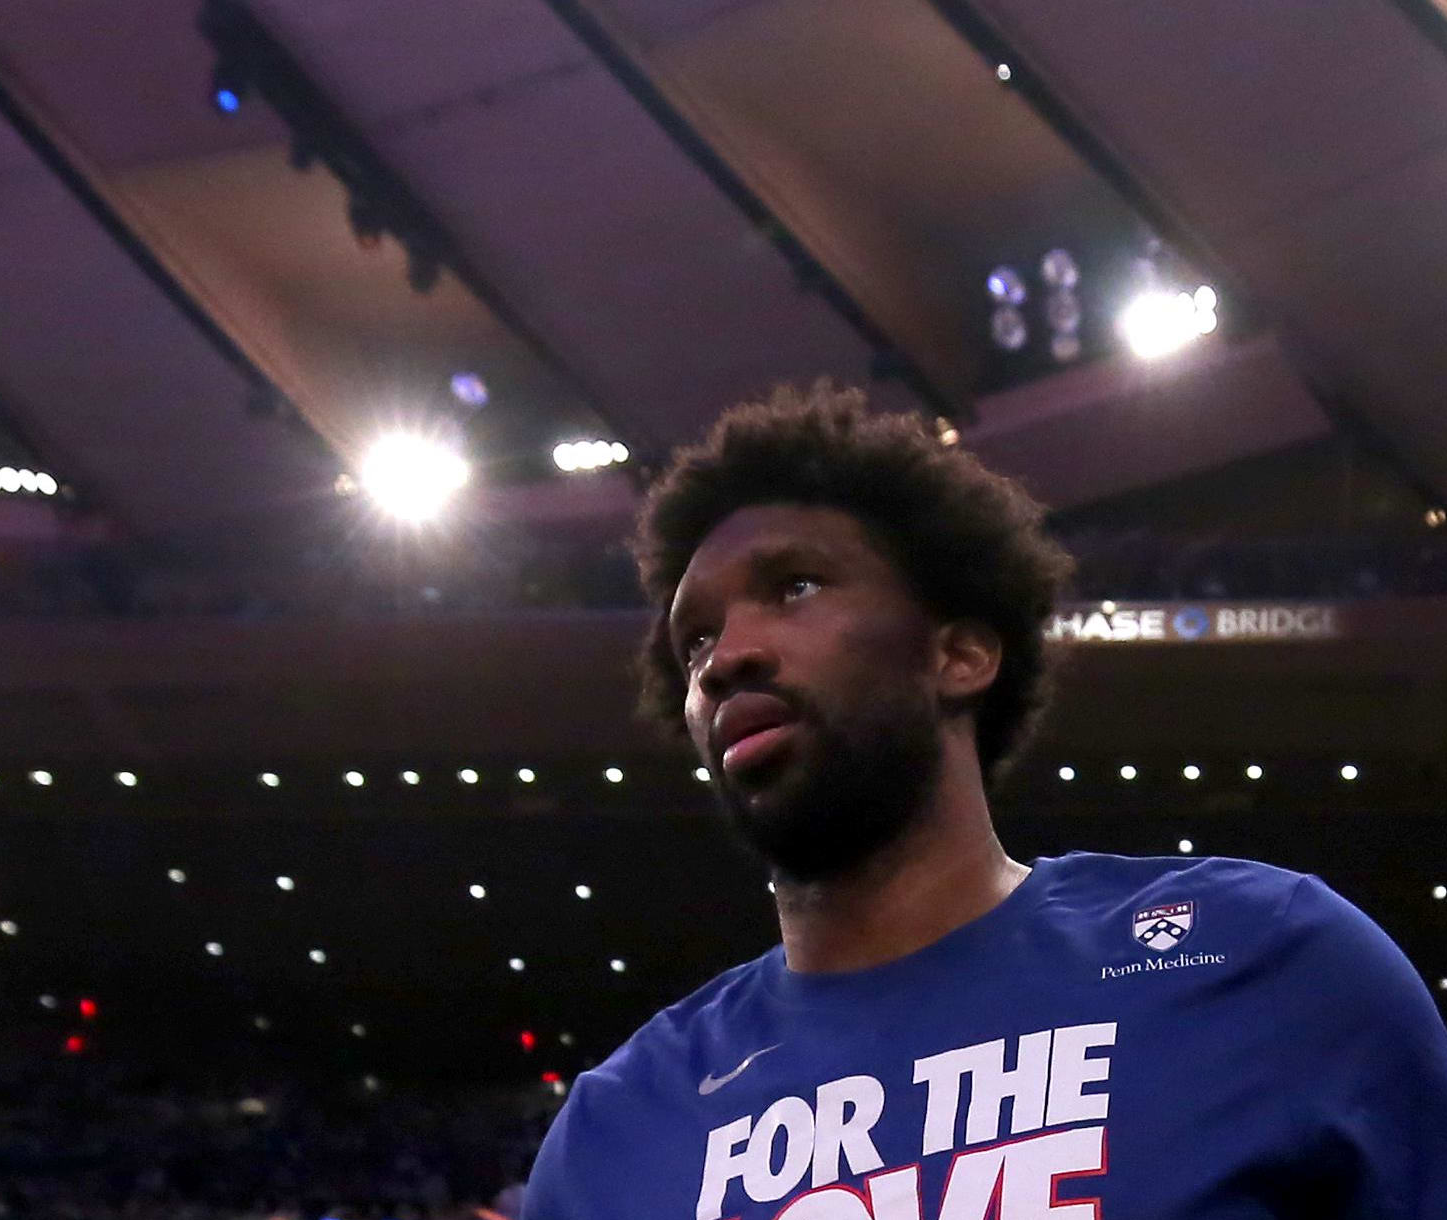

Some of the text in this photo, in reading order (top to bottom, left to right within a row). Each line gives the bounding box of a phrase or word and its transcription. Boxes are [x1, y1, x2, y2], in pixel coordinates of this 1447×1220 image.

[1101, 951, 1226, 980] Penn Medicine
[913, 1022, 1117, 1156] THE
